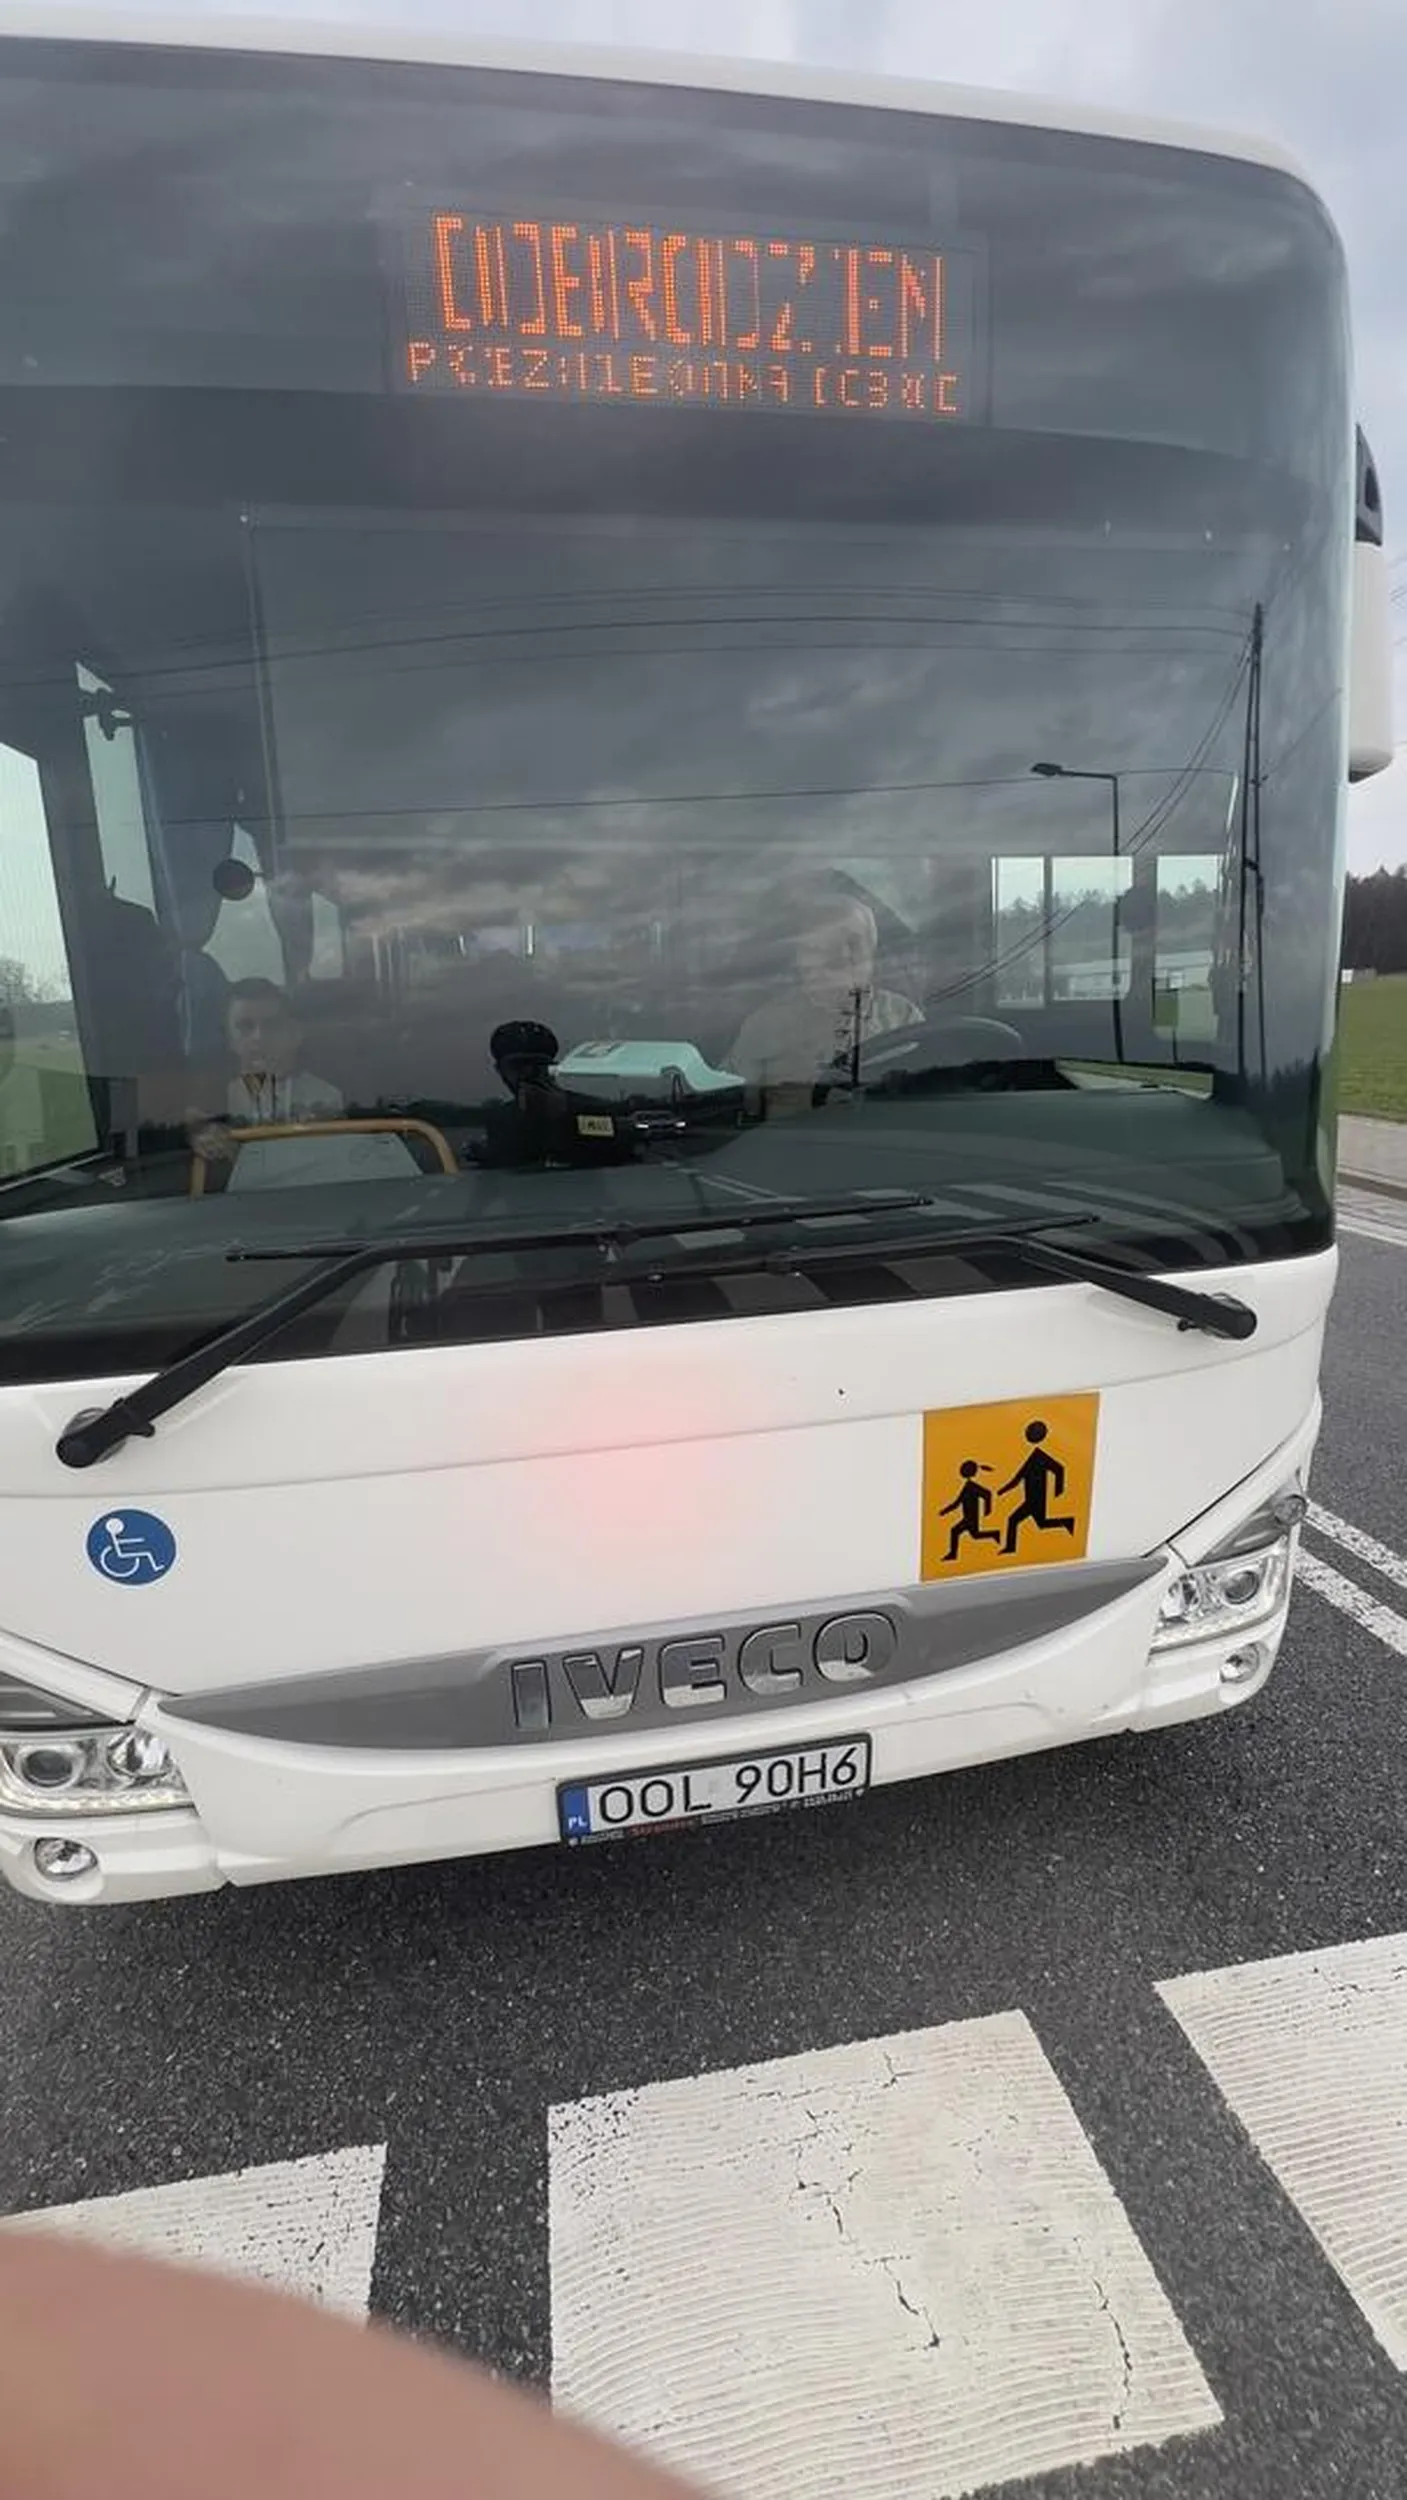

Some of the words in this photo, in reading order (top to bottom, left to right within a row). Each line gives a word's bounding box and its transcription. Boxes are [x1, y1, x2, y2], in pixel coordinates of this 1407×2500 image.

[511, 1609, 899, 1730] IVECO
[568, 1815, 588, 1829] PL
[600, 1775, 712, 1824] OOL
[735, 1746, 859, 1804] 90H6
